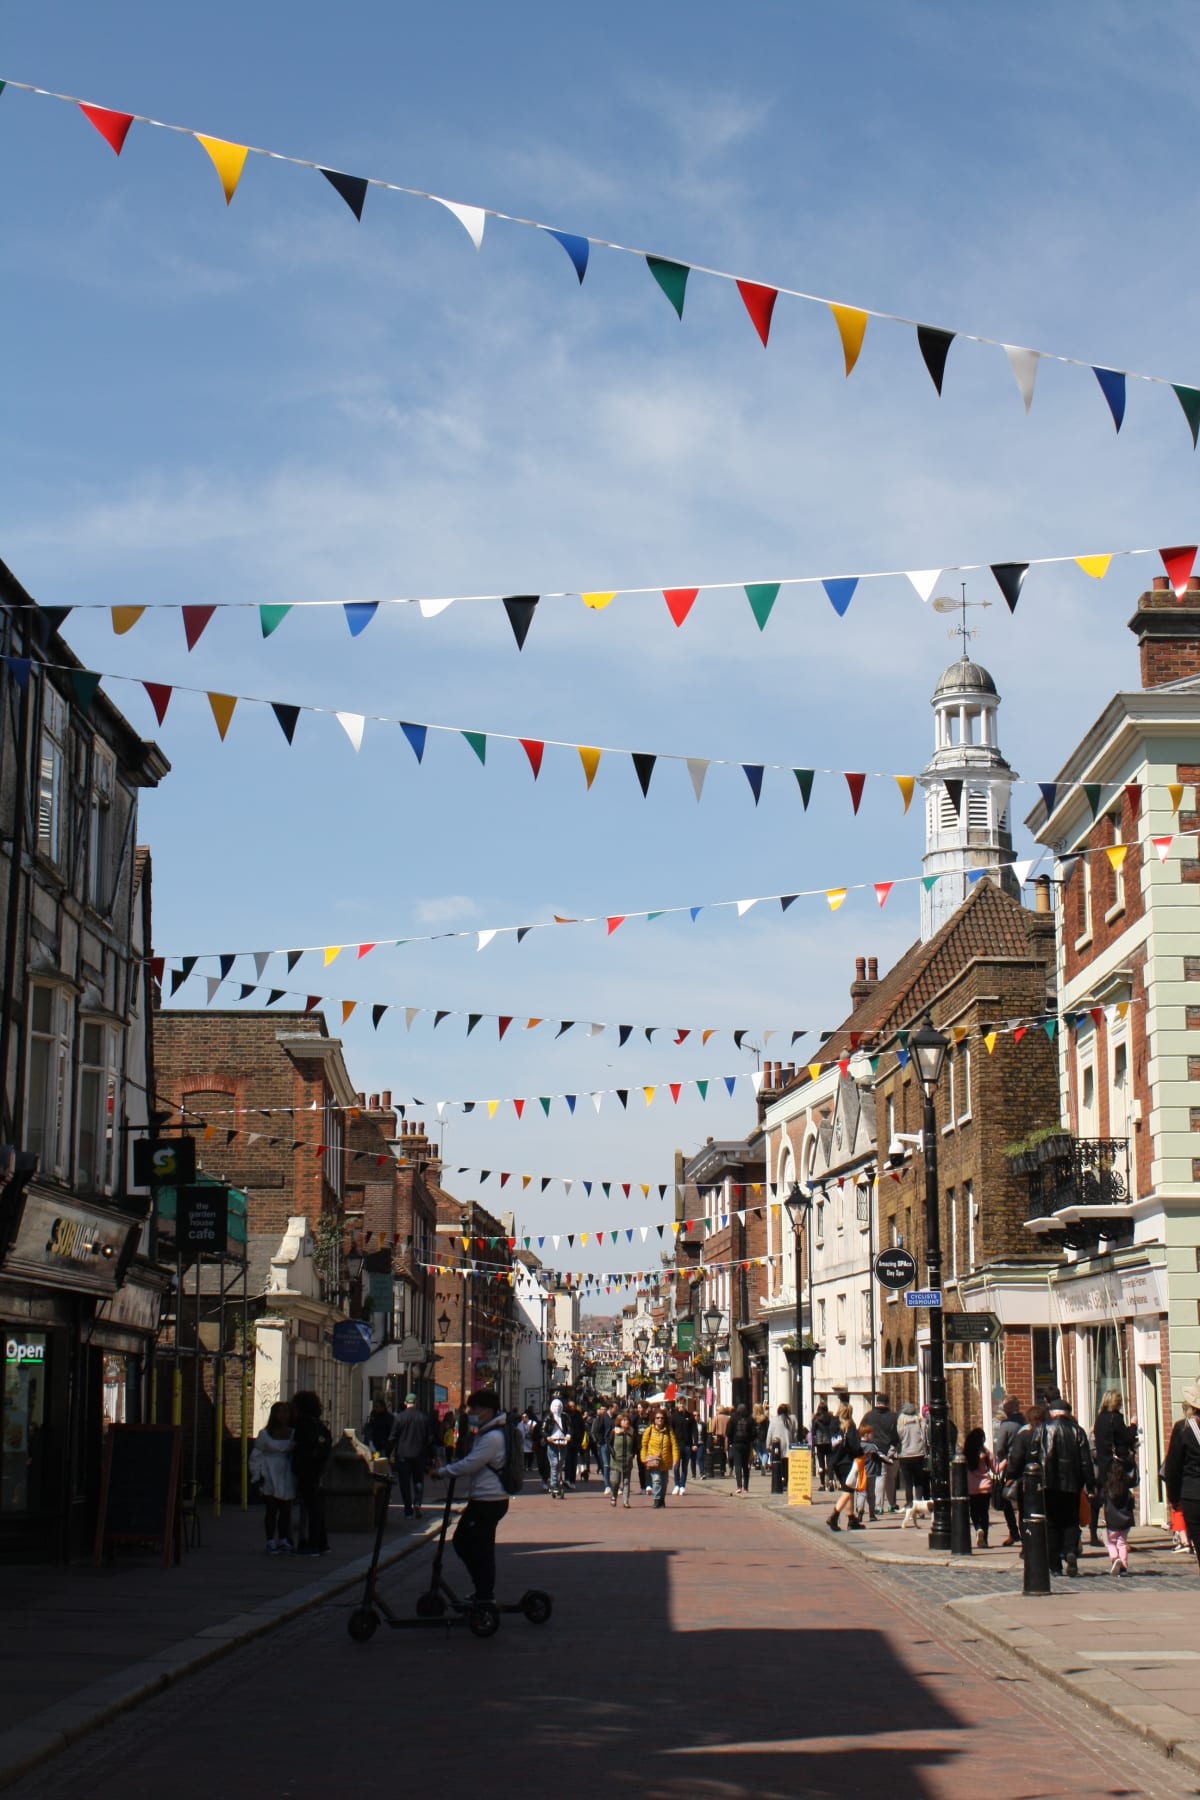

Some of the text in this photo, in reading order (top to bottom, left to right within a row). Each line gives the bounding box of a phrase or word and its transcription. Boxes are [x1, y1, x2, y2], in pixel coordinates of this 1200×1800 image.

[196, 1202, 209, 1210] the
[188, 1211, 216, 1219] garden
[878, 1260, 897, 1268] Amazing
[6, 1339, 44, 1363] Open
